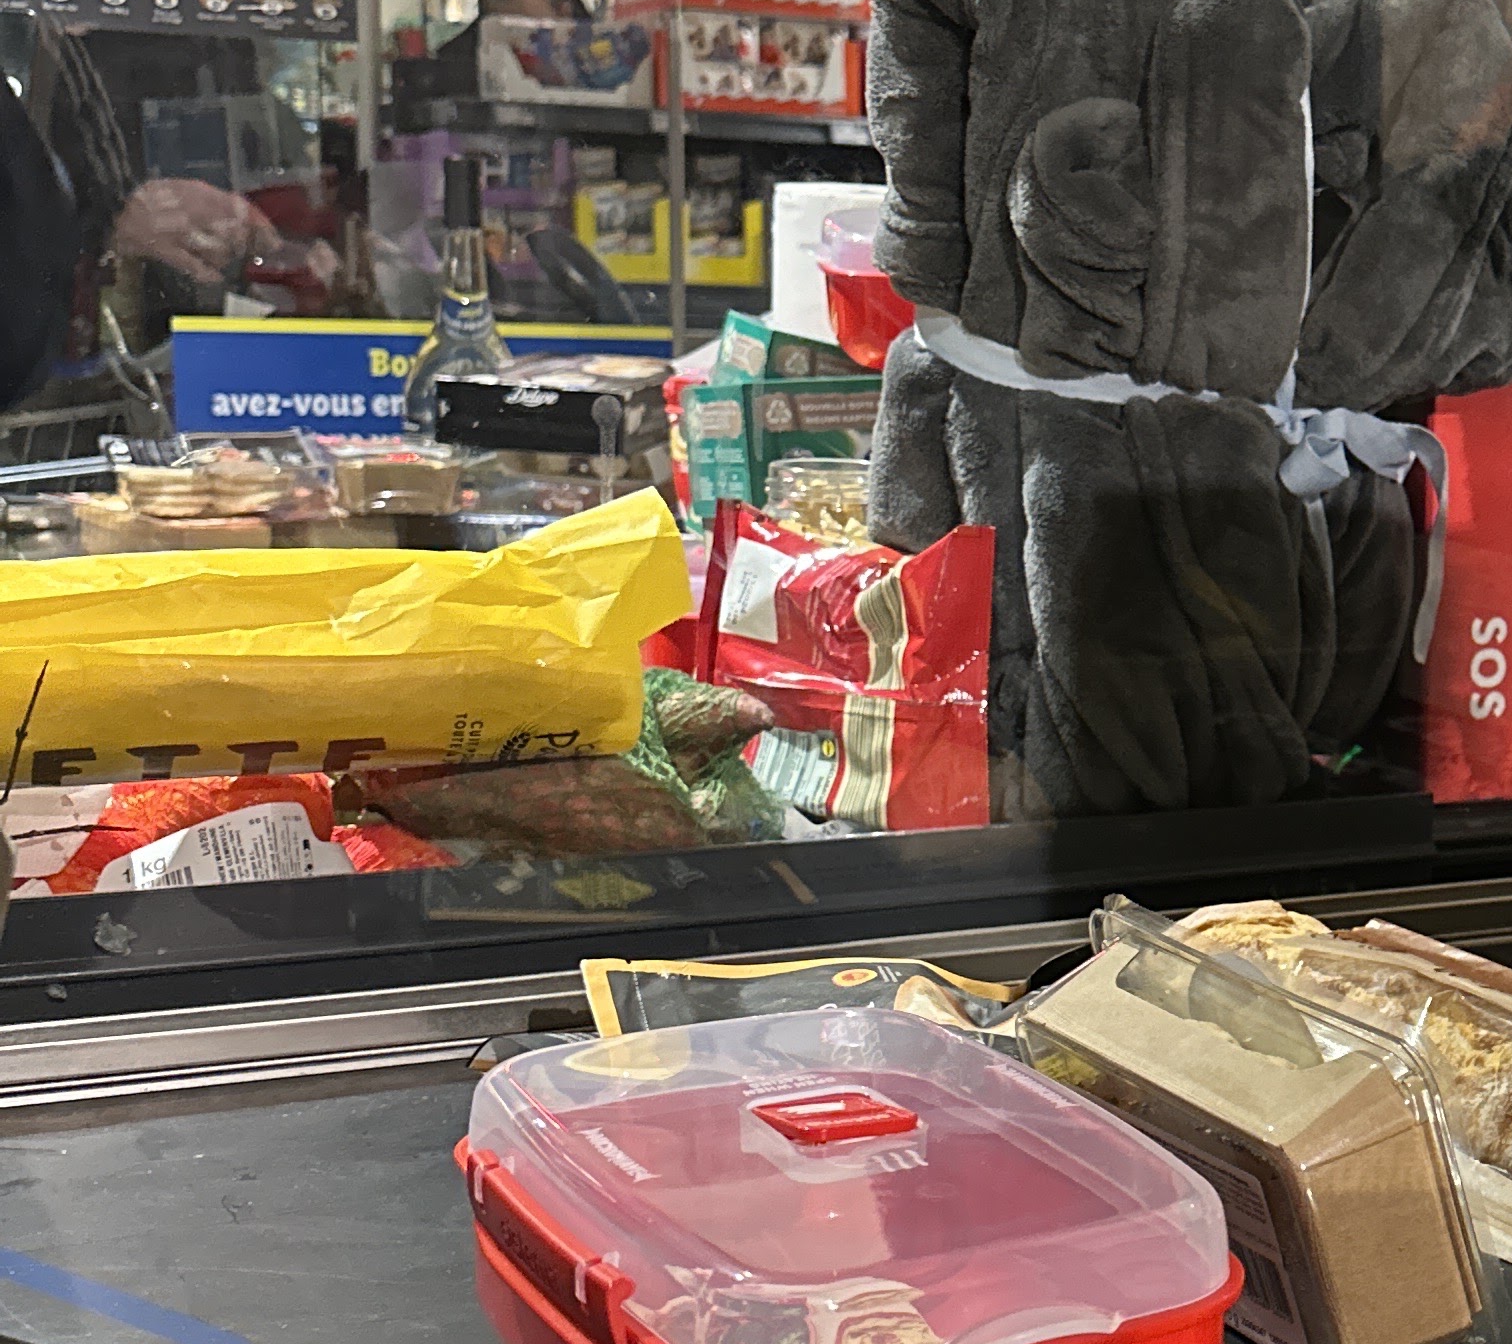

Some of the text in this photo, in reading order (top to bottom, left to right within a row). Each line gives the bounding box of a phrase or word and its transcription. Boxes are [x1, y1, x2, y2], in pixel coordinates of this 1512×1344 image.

[212, 392, 367, 417] avez-vous
[1468, 615, 1509, 721] SOS
[141, 857, 167, 877] kg
